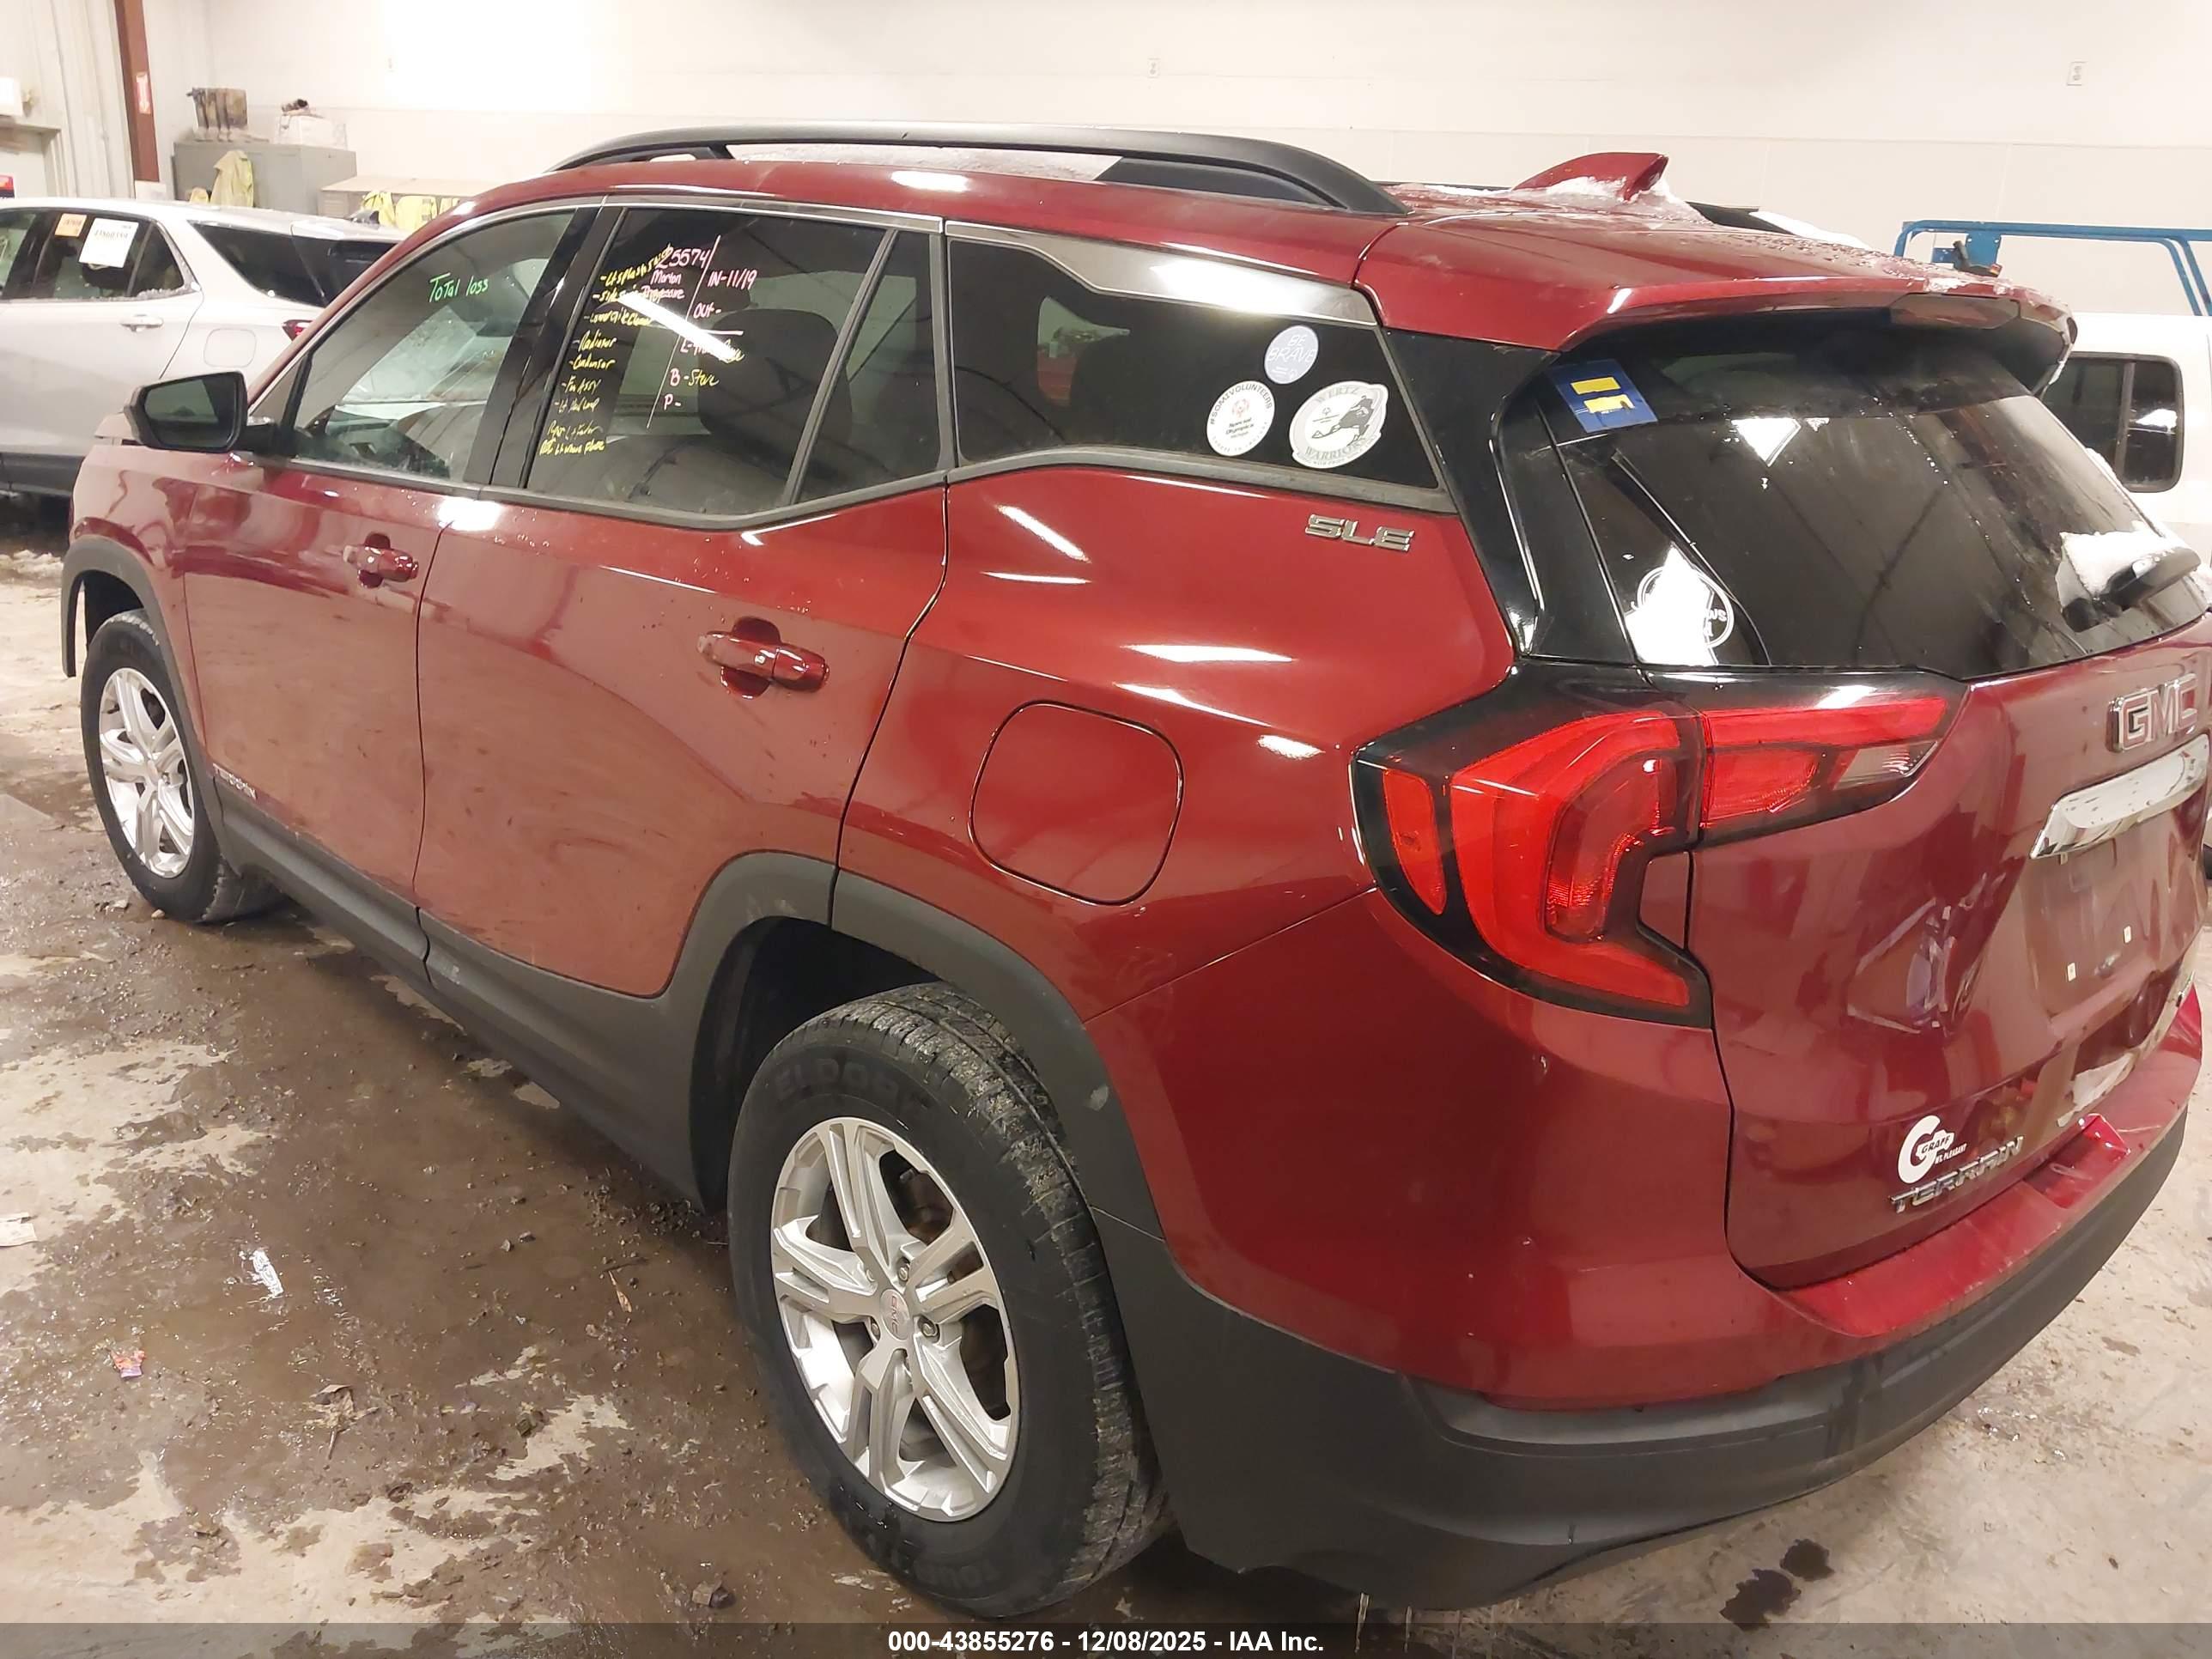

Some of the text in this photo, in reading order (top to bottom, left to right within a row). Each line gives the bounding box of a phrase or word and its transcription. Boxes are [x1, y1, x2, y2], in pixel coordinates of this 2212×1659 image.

[655, 247, 711, 269] 25574
[465, 275, 489, 296] loss
[1287, 333, 1308, 347] BE
[1267, 347, 1318, 363] BRAVE
[1305, 514, 1415, 552] SLE
[2106, 673, 2197, 753] GMC
[1921, 1134, 1951, 1153] GRAFF
[1889, 1135, 2024, 1213] TERRAIN
